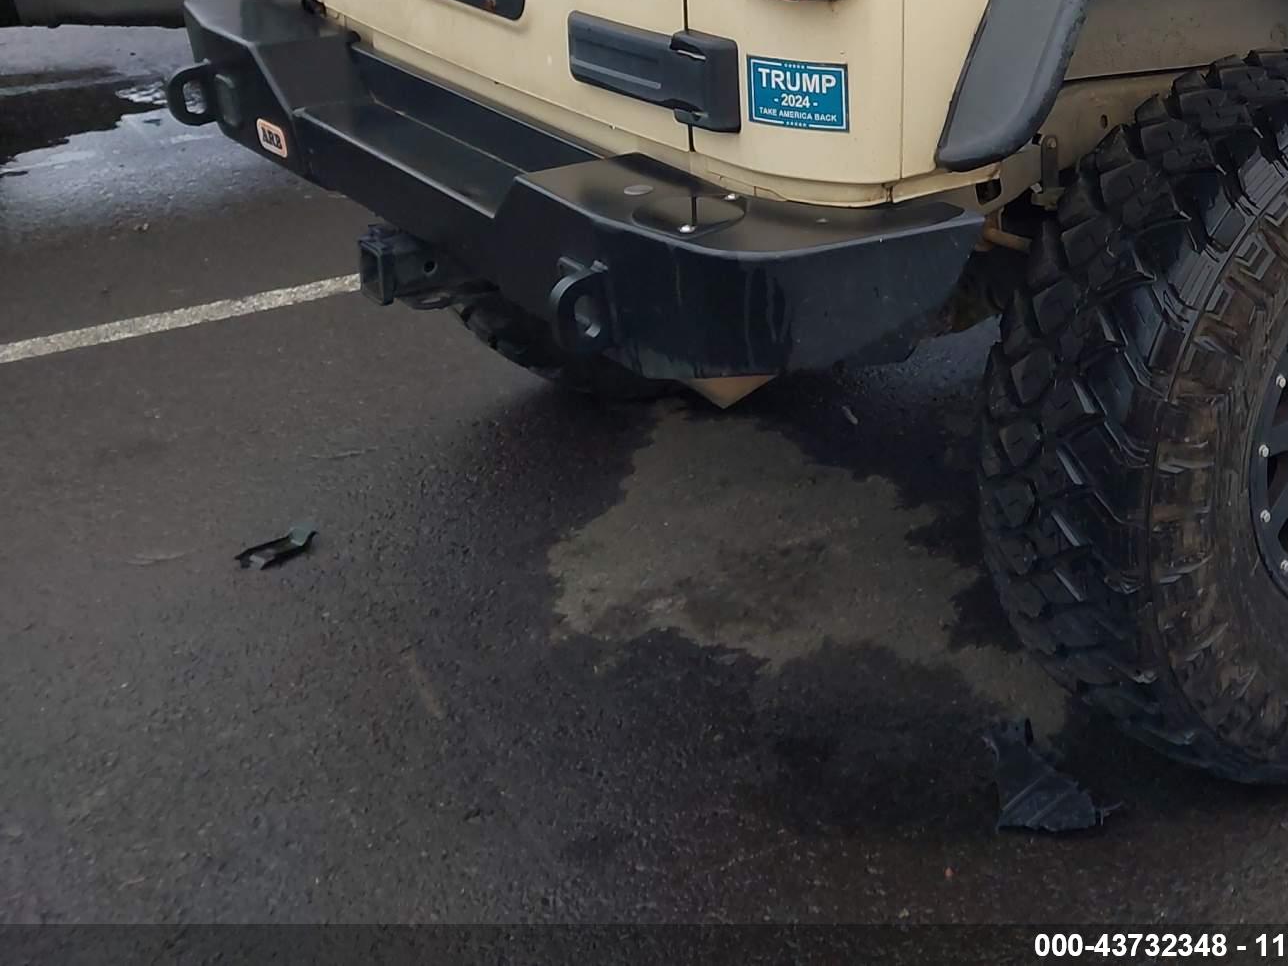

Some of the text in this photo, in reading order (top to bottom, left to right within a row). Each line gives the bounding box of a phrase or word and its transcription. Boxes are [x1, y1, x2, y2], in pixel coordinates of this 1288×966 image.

[758, 67, 837, 94] TRUMP
[781, 93, 810, 108] 2024
[759, 106, 837, 122] TAKE AMERICA BACK
